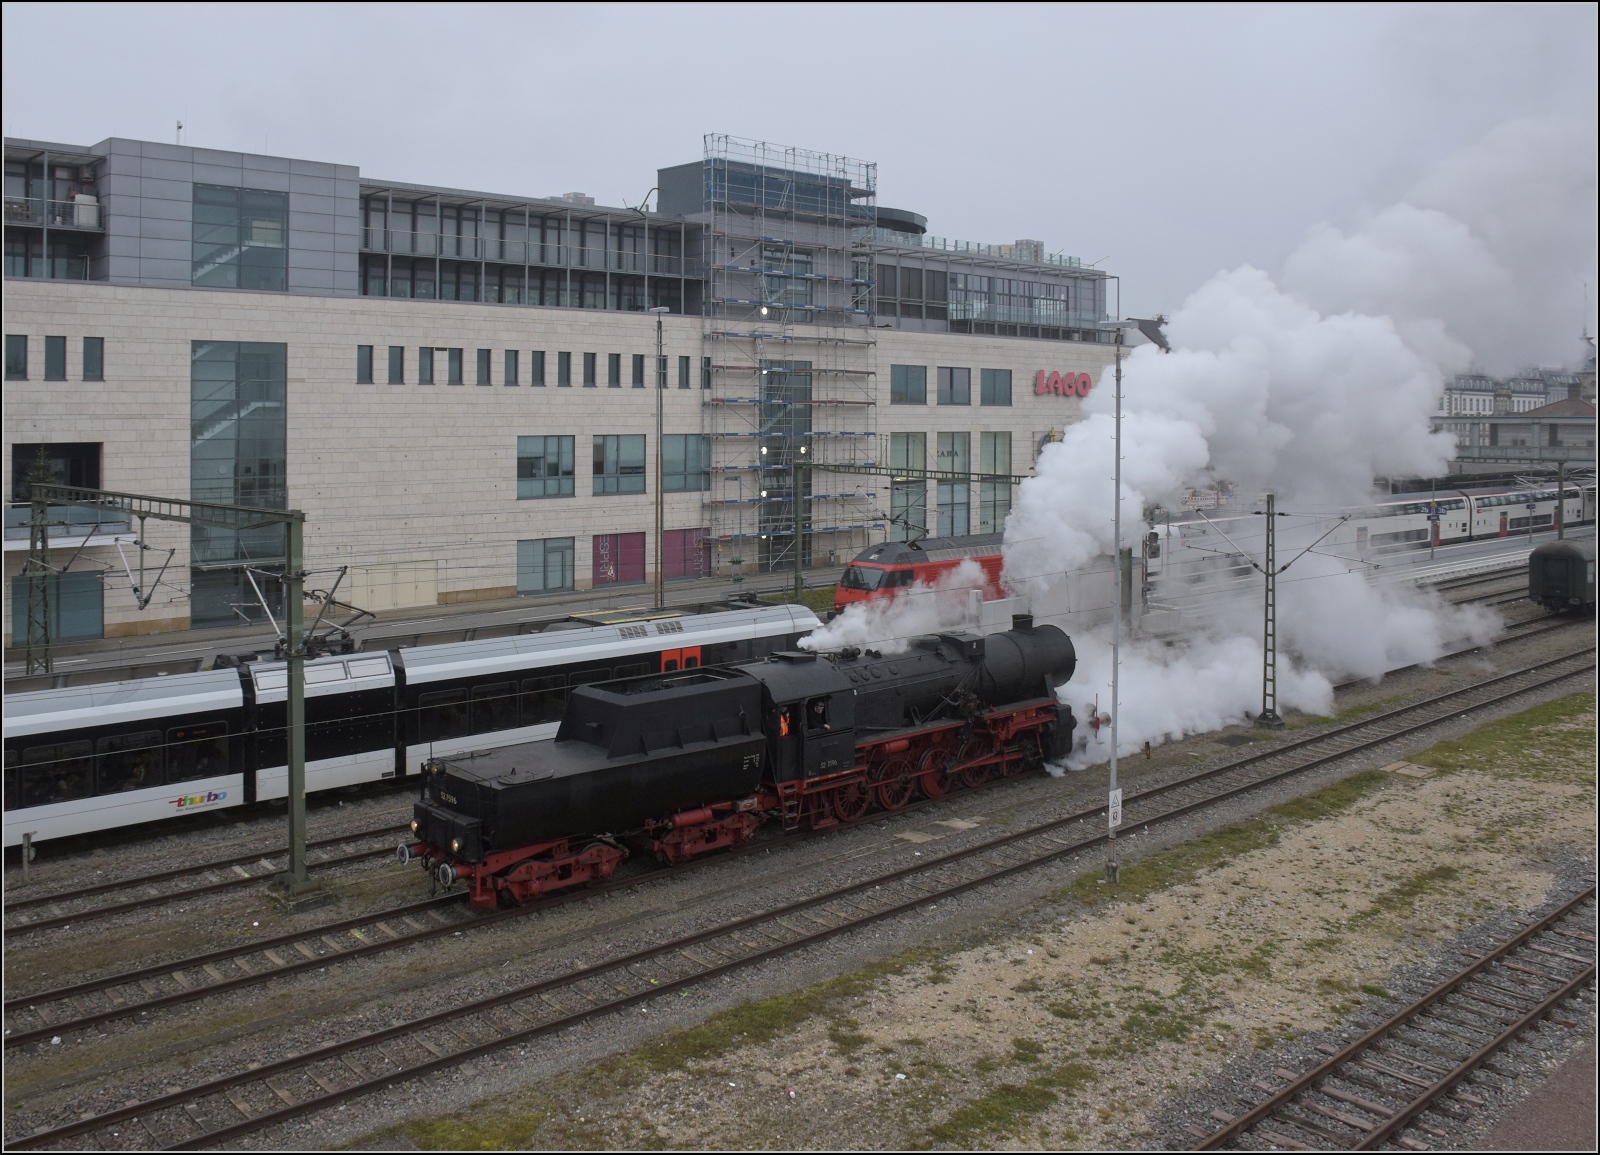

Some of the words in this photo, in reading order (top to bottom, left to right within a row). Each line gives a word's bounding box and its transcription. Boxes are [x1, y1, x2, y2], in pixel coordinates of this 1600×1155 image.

[1035, 369, 1092, 397] LAGO
[1420, 506, 1429, 514] 2b
[1437, 507, 1447, 515] 3b
[599, 533, 611, 580] ESPRIT
[168, 791, 228, 808] thurbo
